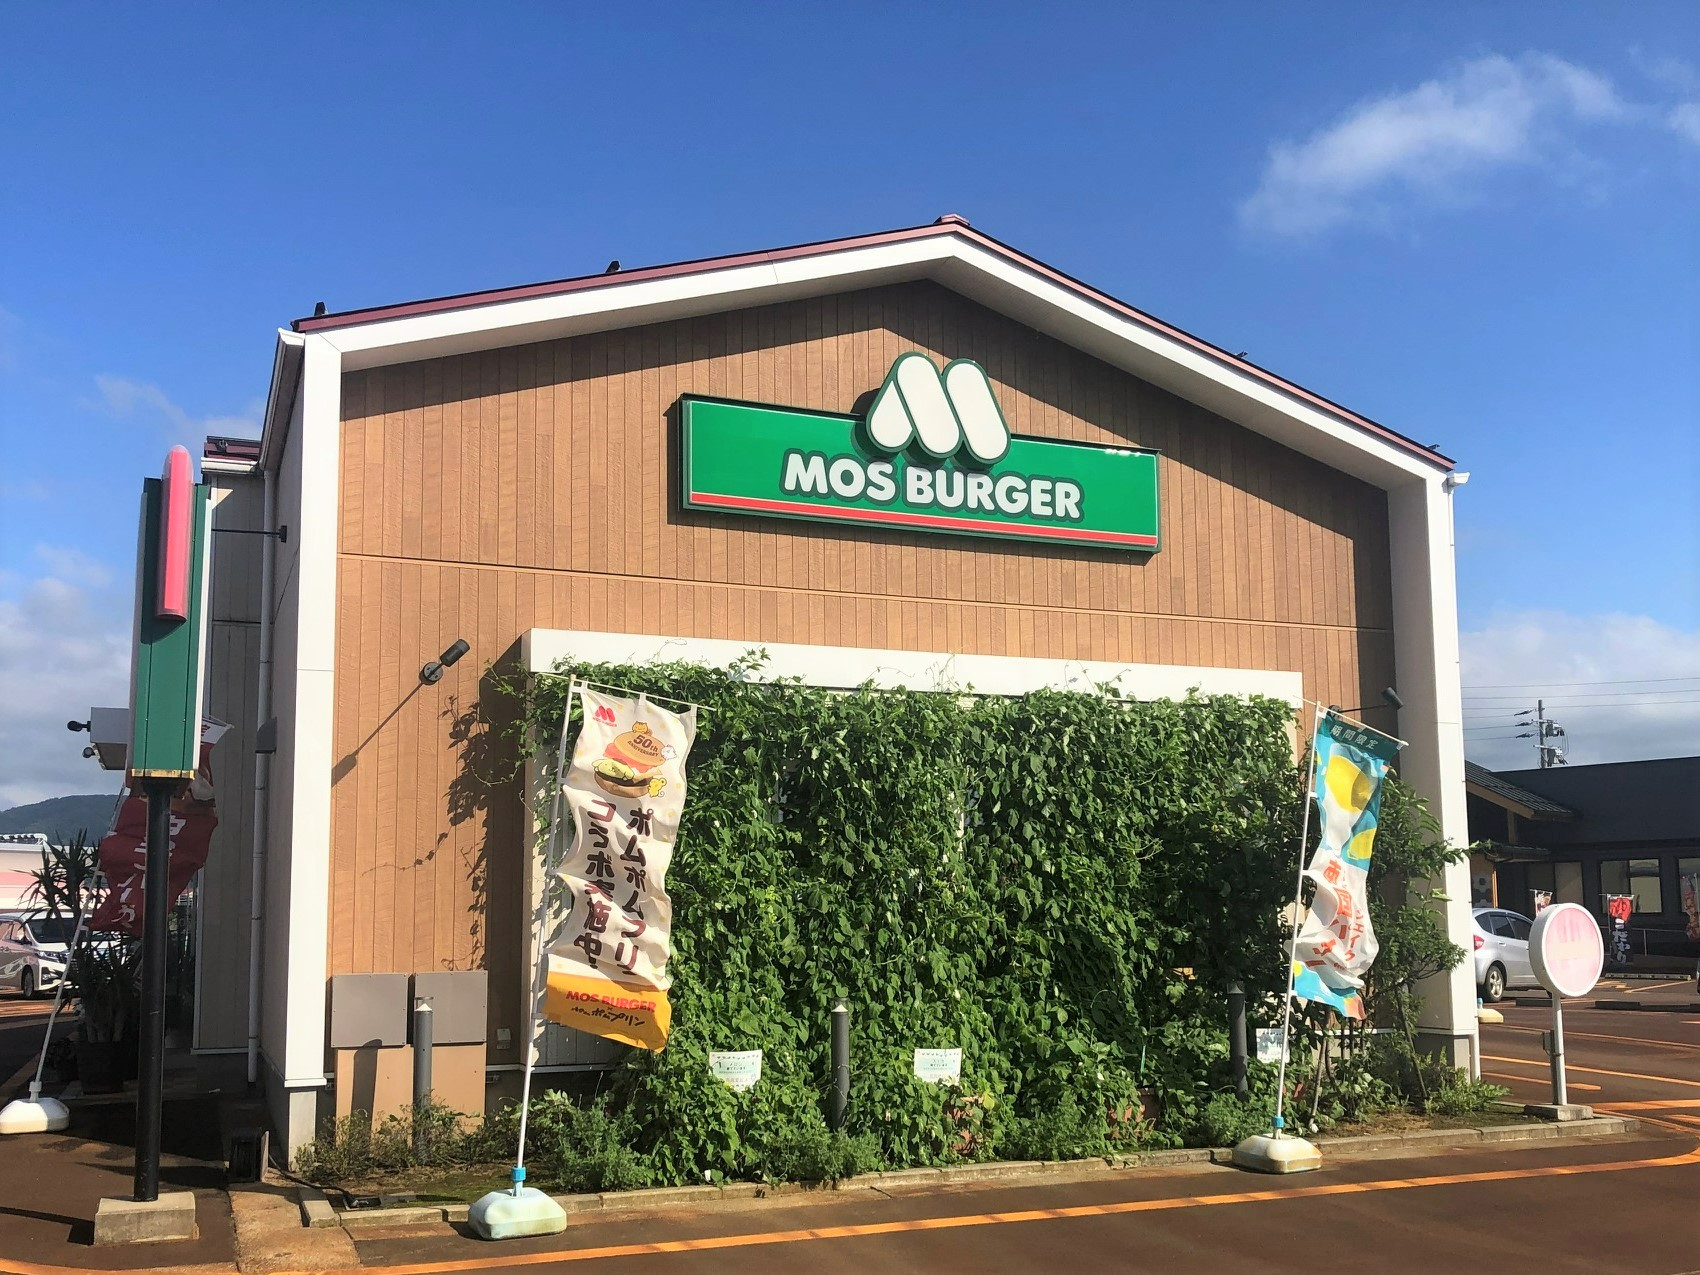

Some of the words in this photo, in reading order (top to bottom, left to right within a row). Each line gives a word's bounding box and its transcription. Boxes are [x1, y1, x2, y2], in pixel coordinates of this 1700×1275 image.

[784, 453, 896, 501] MOS
[906, 465, 1081, 519] BURGER
[633, 734, 659, 753] 50th
[1330, 724, 1379, 750] 期間限定
[566, 990, 600, 1004] MOS
[601, 995, 657, 1013] BURGER
